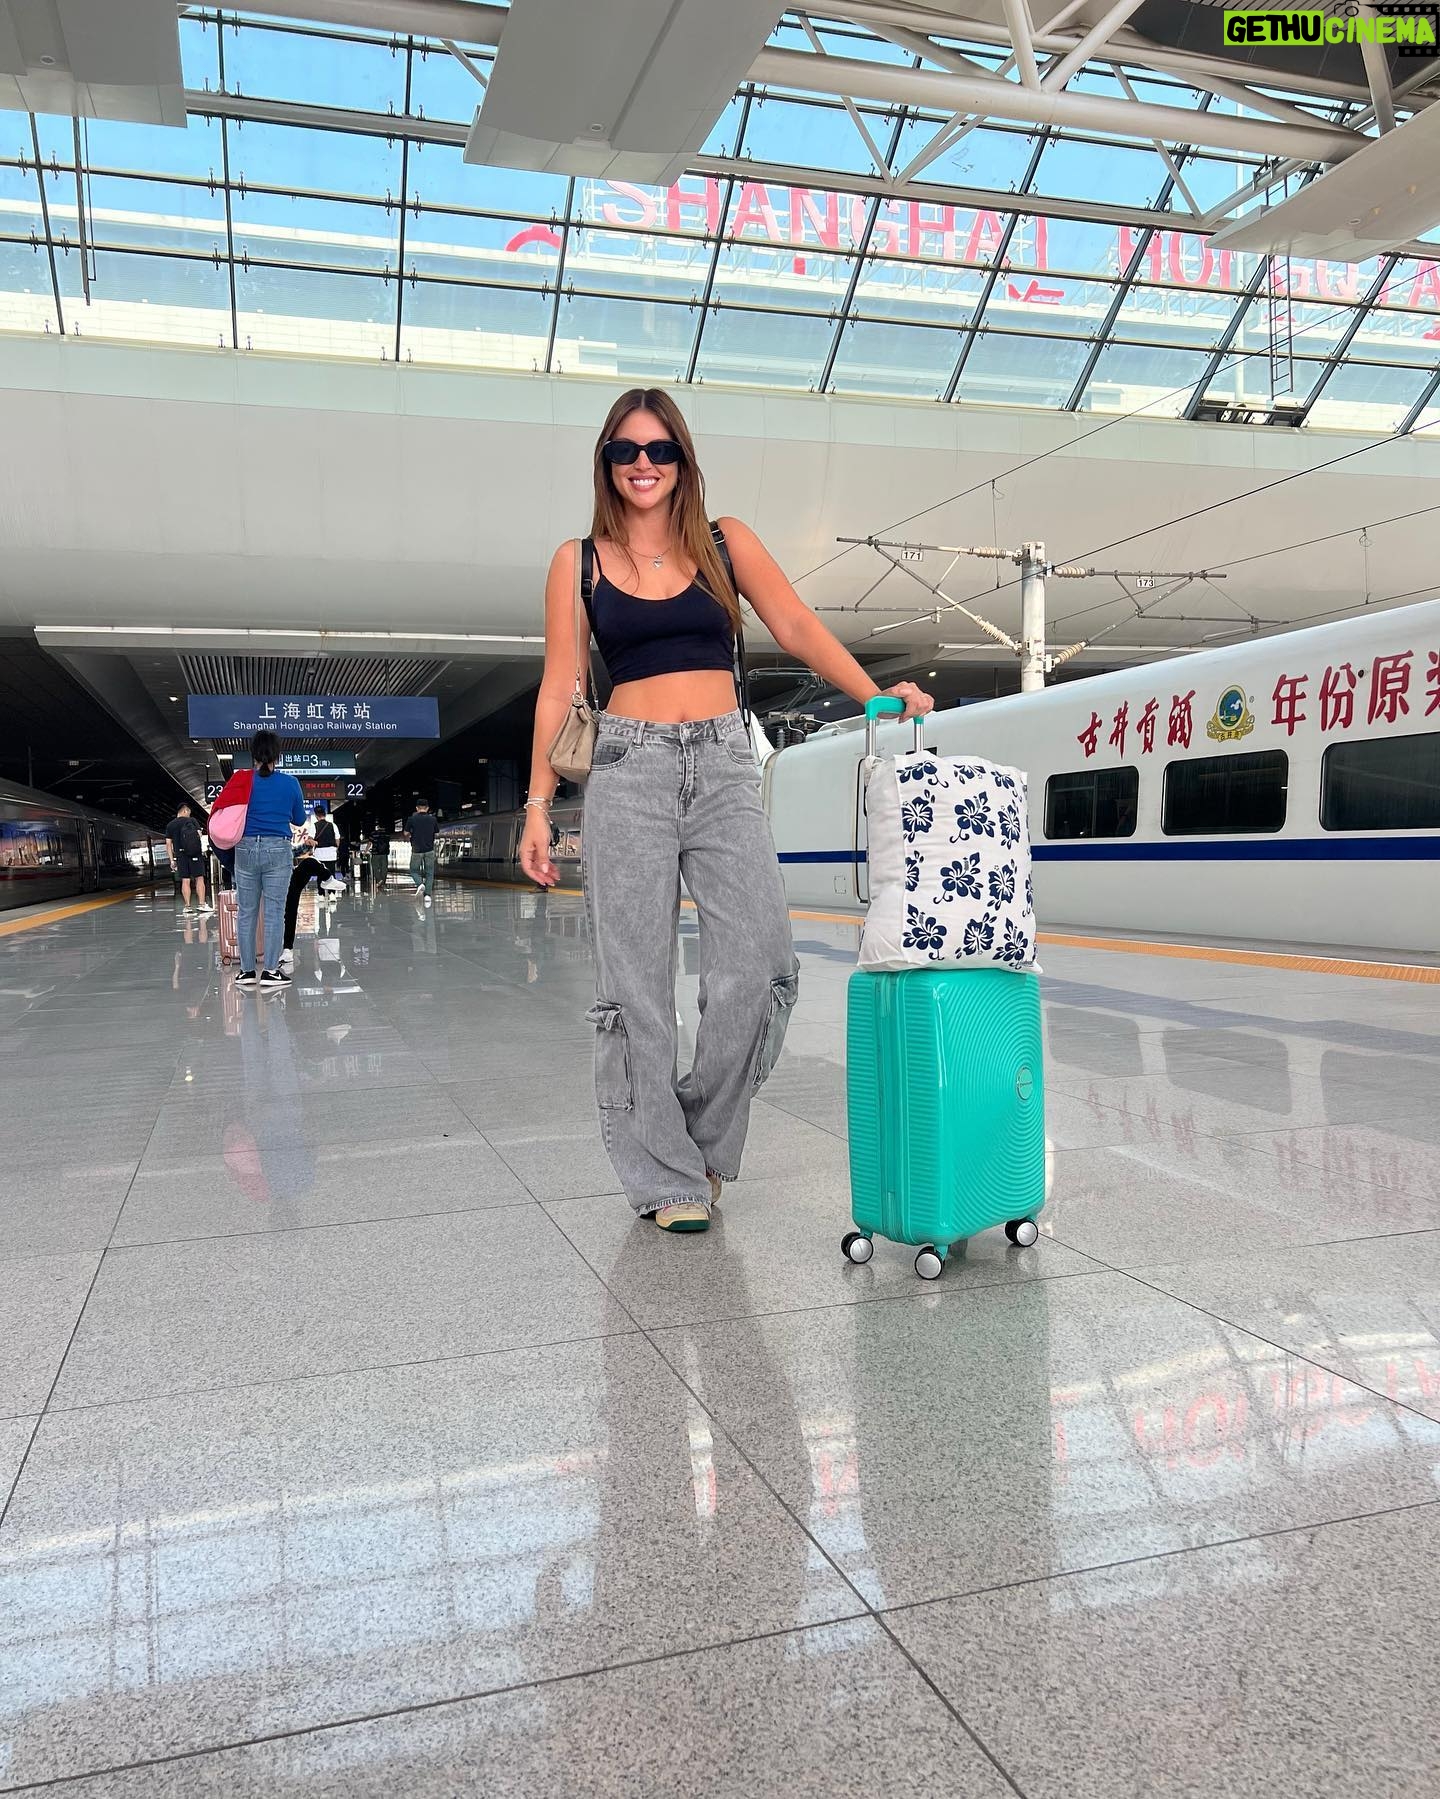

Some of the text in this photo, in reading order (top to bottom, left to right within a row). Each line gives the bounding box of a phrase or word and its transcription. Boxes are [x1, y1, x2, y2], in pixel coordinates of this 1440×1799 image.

[904, 551, 921, 560] 171
[1139, 579, 1153, 587] 173
[259, 702, 371, 719] 上海虹桥站
[233, 721, 397, 731] Shanghai Hongqiao Railway Station
[207, 785, 224, 798] 23
[347, 783, 364, 796] 22
